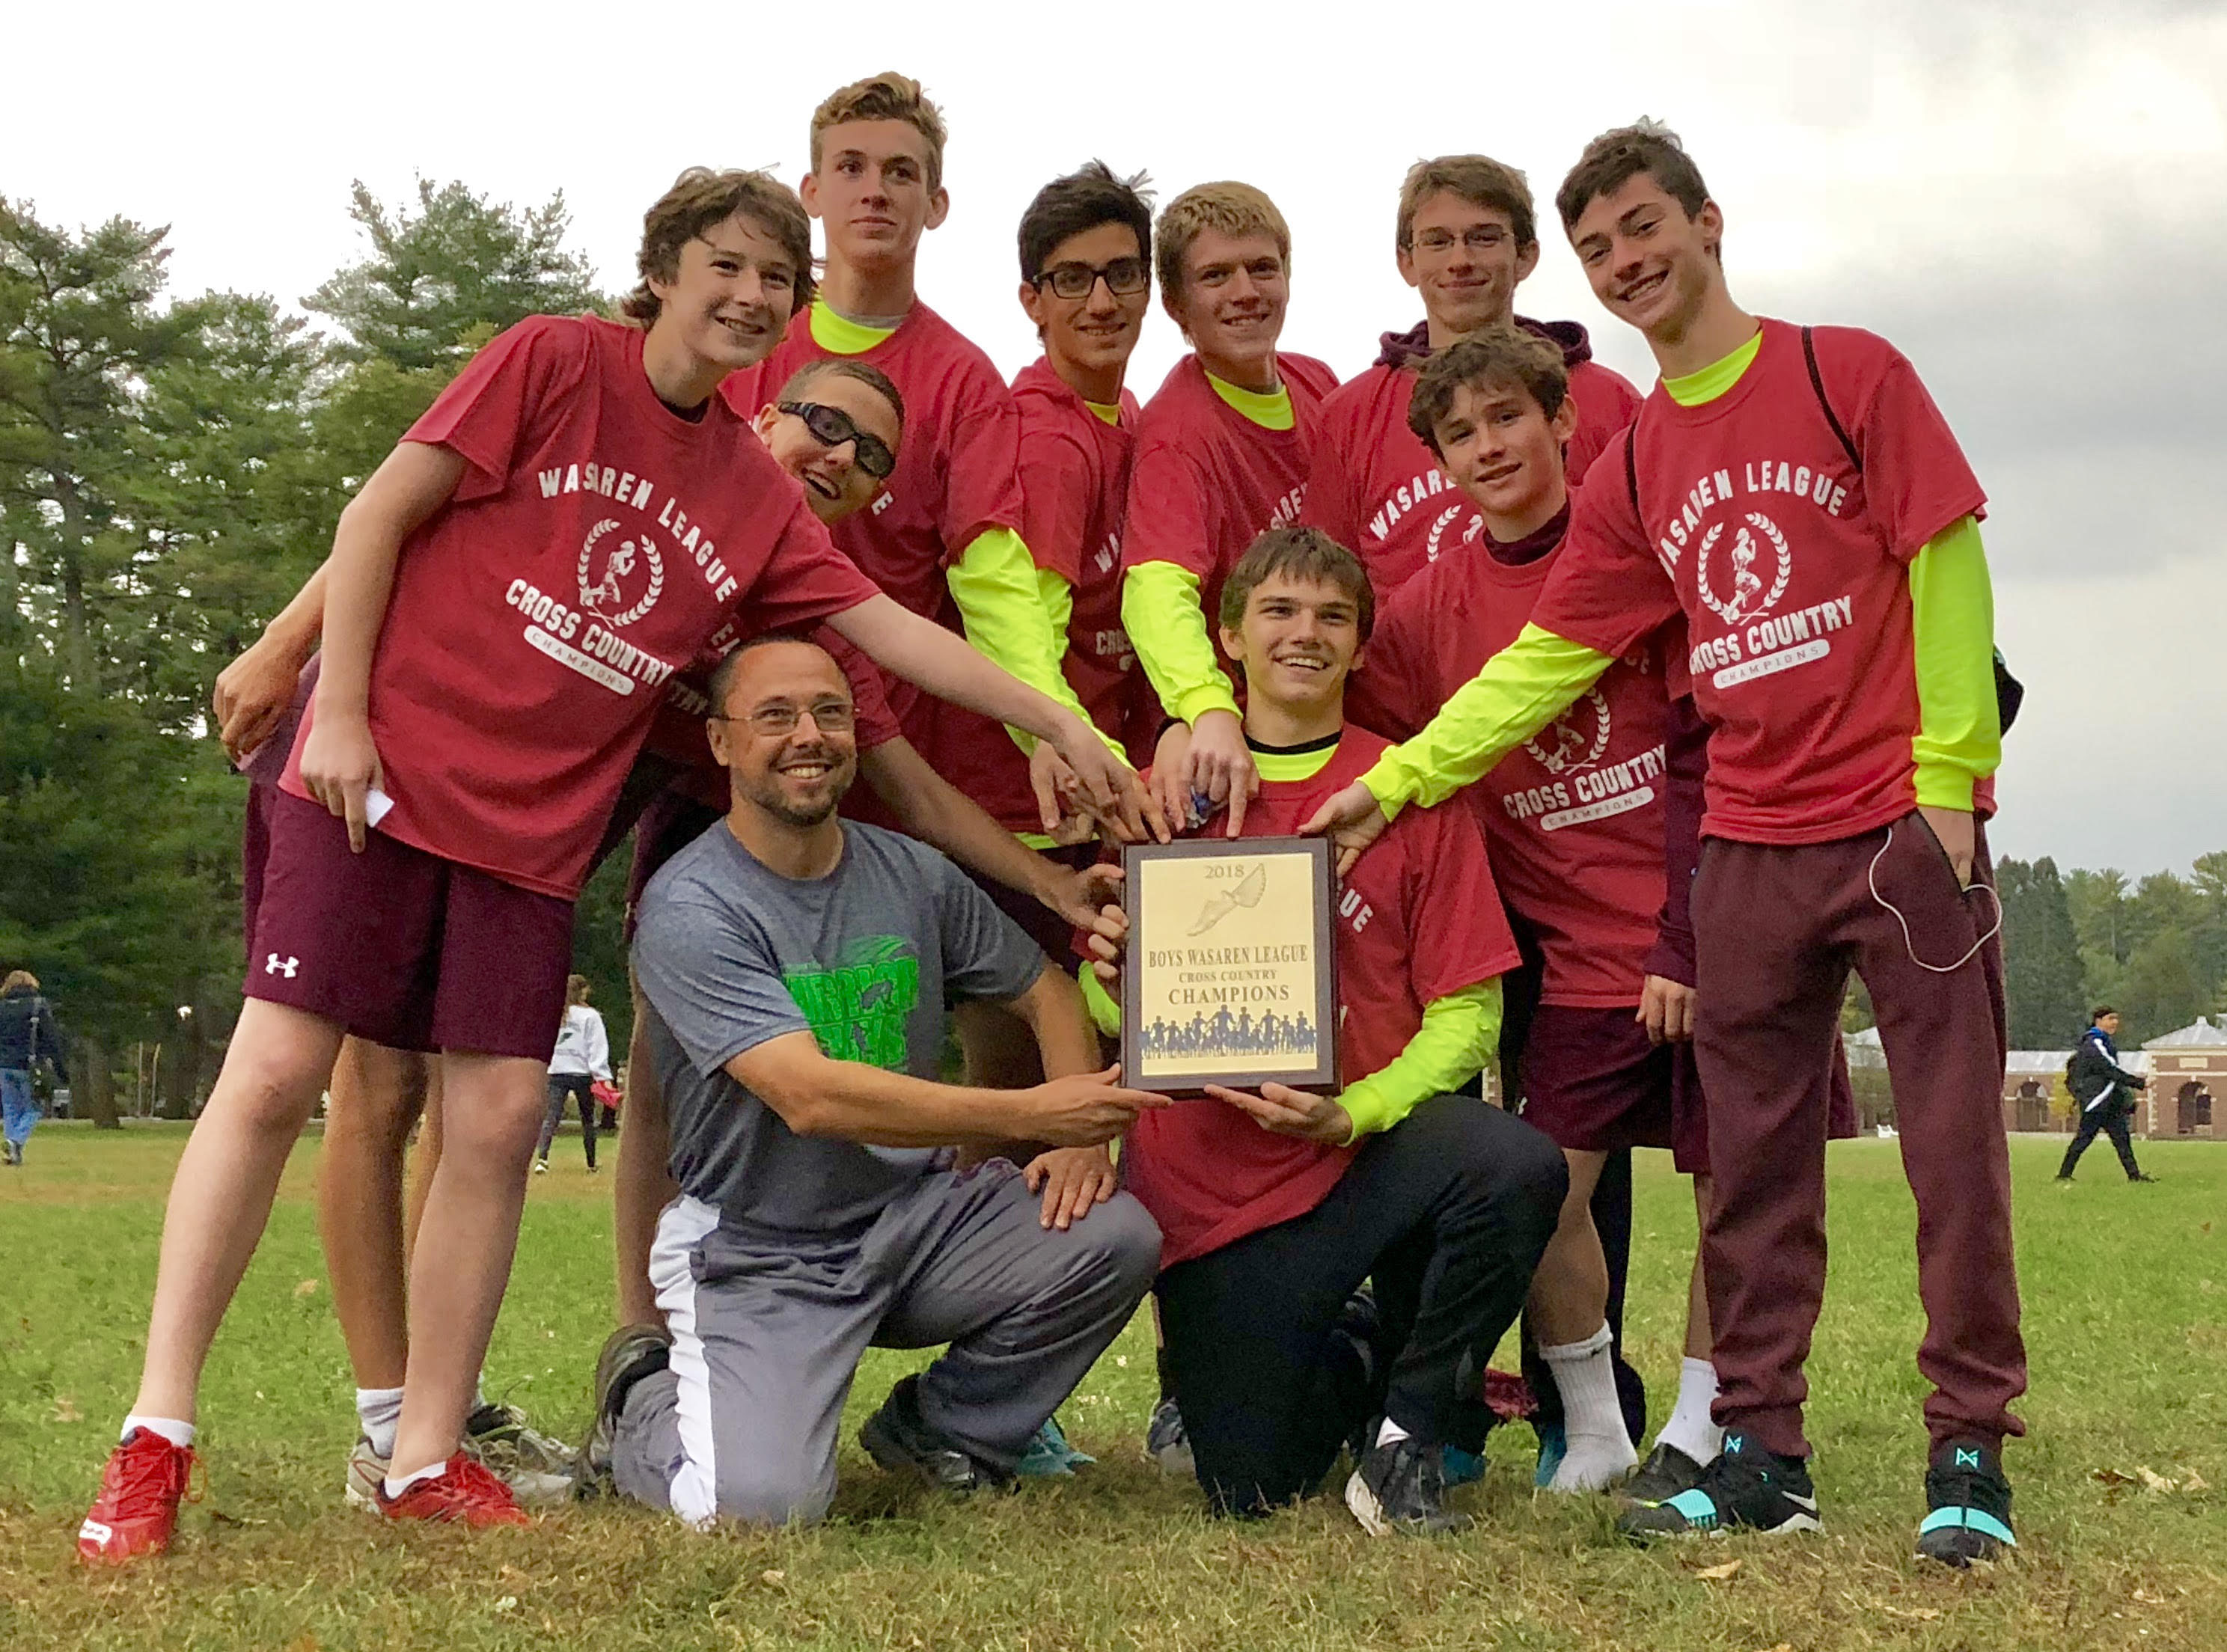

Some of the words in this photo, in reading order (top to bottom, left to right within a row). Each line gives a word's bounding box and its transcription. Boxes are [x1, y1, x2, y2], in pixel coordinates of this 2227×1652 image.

[1369, 468, 1457, 542] WASAR
[1658, 468, 1734, 582] ASAEN
[1746, 460, 1847, 516] LEAGUE
[658, 497, 739, 602] LEAGUE
[506, 578, 581, 640] CROSS
[581, 623, 674, 687] COUNTRY
[1747, 595, 1853, 655] COUNTRY
[531, 630, 626, 690] CHAMPIONS
[1721, 646, 1819, 684] CHAMPIONS
[1503, 782, 1571, 819] CROSS
[1575, 744, 1667, 803] COUNTRY
[1548, 793, 1645, 827] CHAMPIONS
[1204, 864, 1244, 879] 2018
[1149, 950, 1183, 967] BOYS
[1188, 947, 1250, 965] WASAREN
[1254, 944, 1308, 964] LEAGUE
[1179, 971, 1217, 983] CROSS
[1221, 969, 1277, 982] COUNTRY
[1168, 985, 1289, 1005] CHAMPIONS
